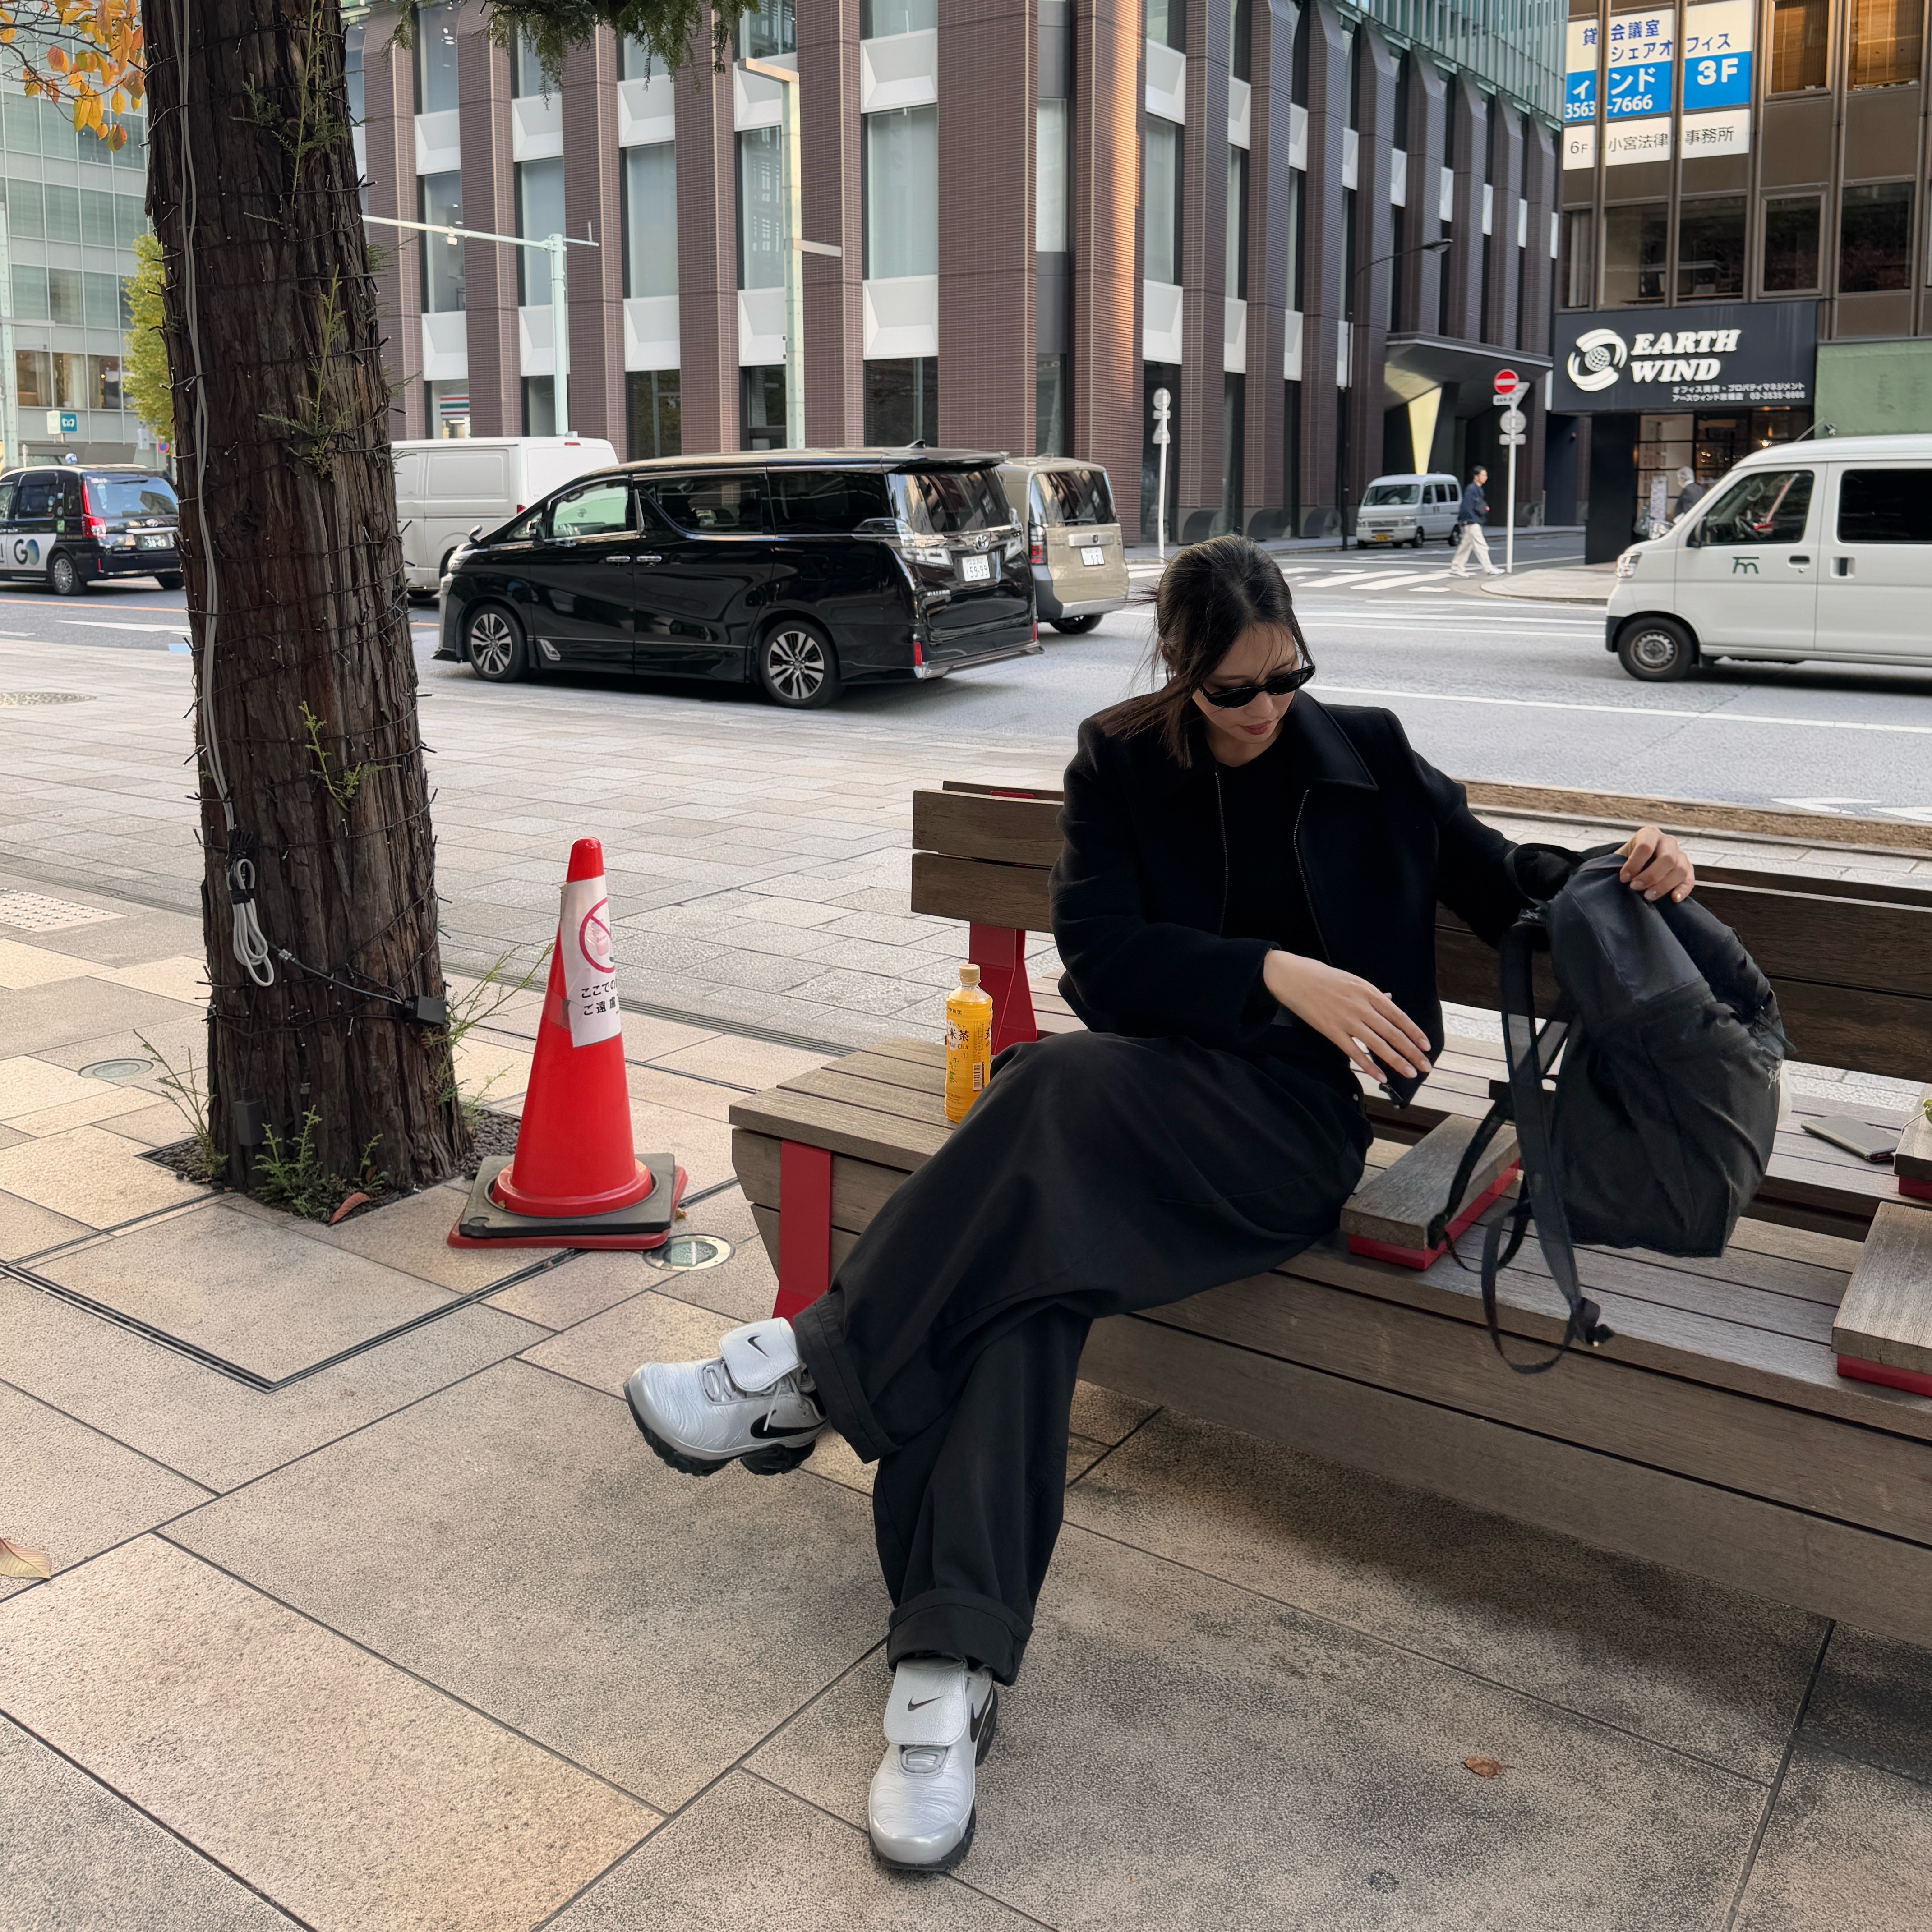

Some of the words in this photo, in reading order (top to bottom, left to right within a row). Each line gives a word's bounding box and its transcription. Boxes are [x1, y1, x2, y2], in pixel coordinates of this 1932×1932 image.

[1611, 33, 1731, 63] シェアオフィス
[1697, 58, 1738, 86] 3F
[1570, 141, 1588, 155] 6F
[1630, 329, 1742, 356] EARTH
[1630, 358, 1721, 383] WIND
